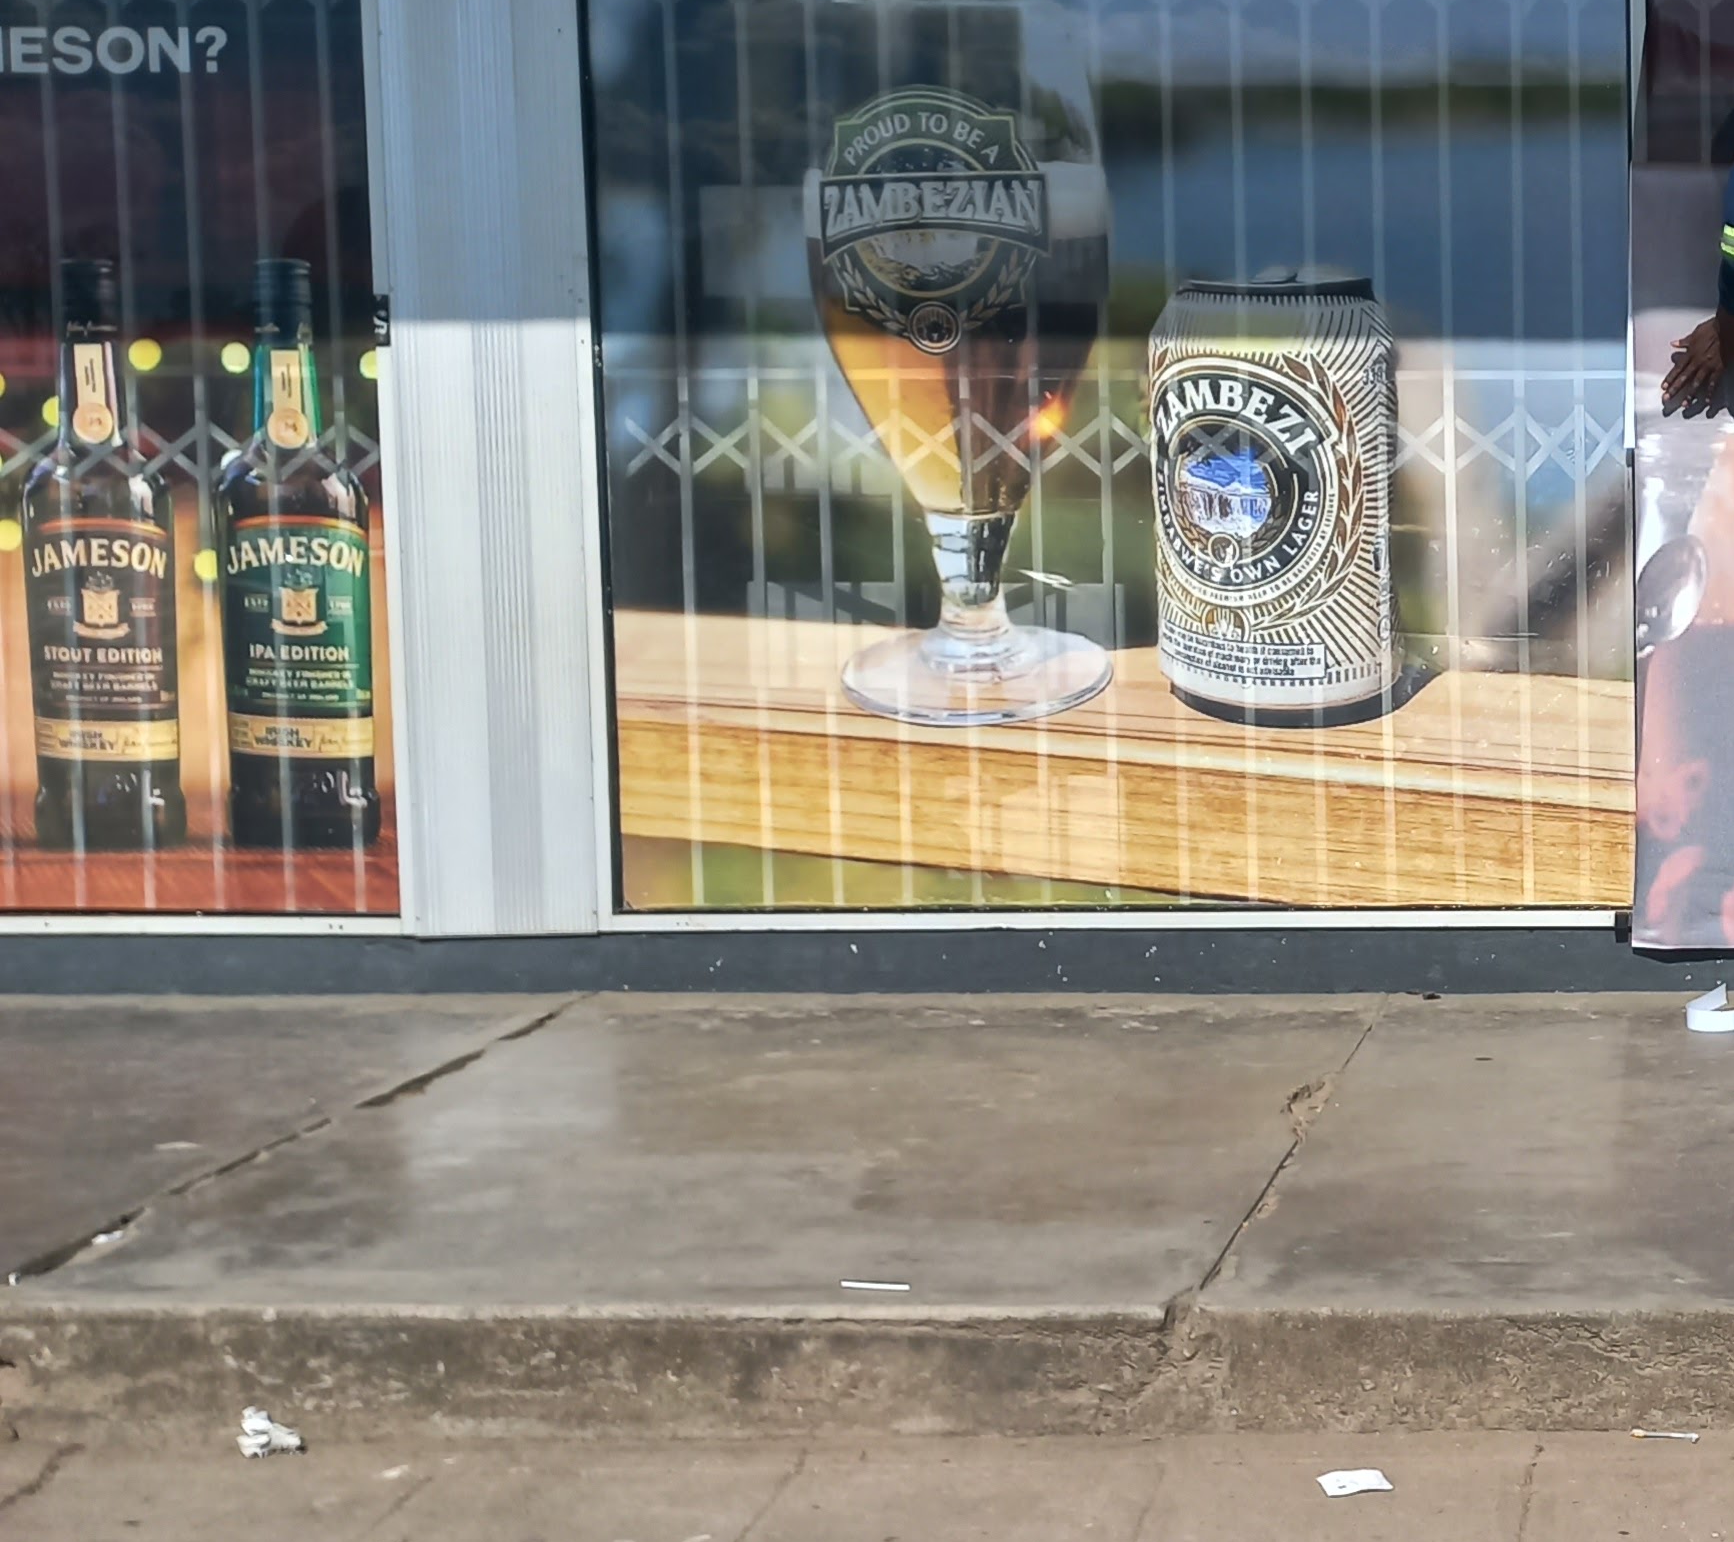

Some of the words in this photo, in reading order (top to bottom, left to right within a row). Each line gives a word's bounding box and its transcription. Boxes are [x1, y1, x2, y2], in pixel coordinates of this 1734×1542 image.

[0, 26, 228, 75] ESON?
[843, 113, 911, 166] PROUD
[918, 111, 948, 134] TO
[952, 121, 985, 149] BE
[981, 144, 1000, 164] A
[823, 179, 1043, 239] ZAMBEZIAN
[1156, 378, 1318, 456] ZAMBEZI
[31, 538, 167, 579] JAMESON
[227, 536, 365, 578] JAMESON
[1231, 555, 1281, 583] OWN
[1281, 490, 1319, 556] LAGER
[44, 645, 92, 663] STOUT
[97, 646, 163, 664] EDITION
[249, 643, 275, 660] IPA
[280, 644, 350, 662] EDITION
